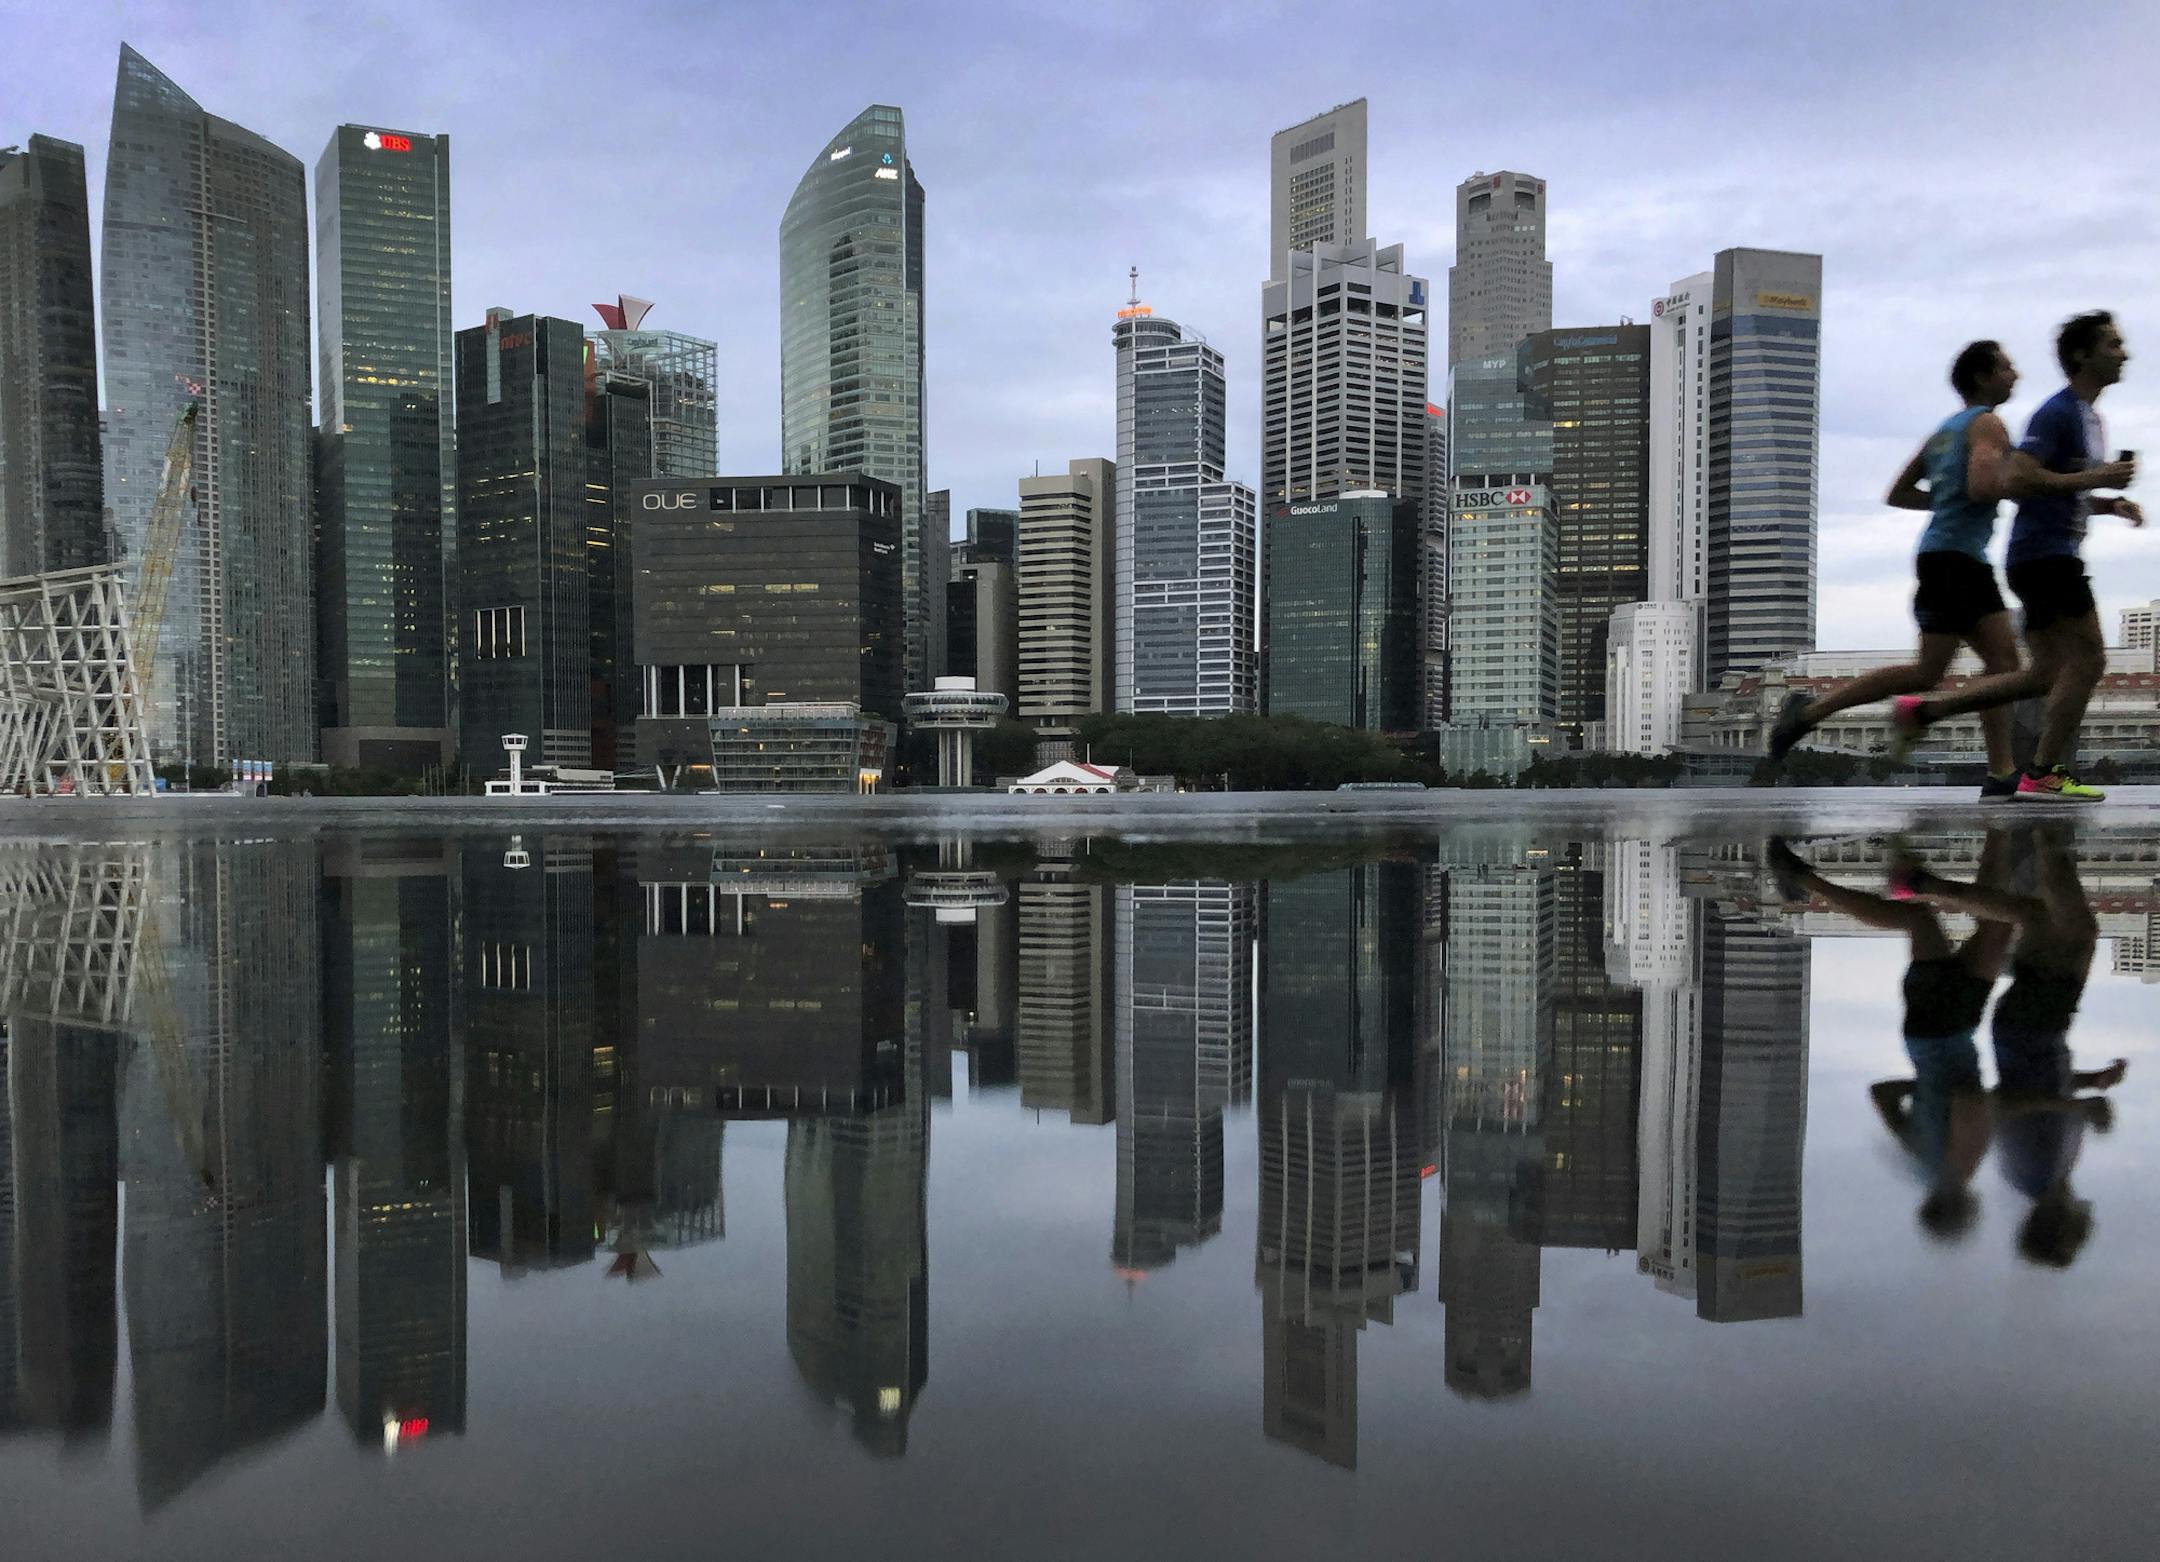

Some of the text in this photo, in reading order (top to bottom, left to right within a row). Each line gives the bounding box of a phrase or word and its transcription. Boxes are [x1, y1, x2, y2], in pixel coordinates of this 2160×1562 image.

[381, 134, 411, 152] UBS
[1483, 359, 1506, 369] MYP
[643, 493, 697, 510] OUE
[1455, 491, 1504, 508] HSBC
[1290, 503, 1338, 516] GuocoLand
